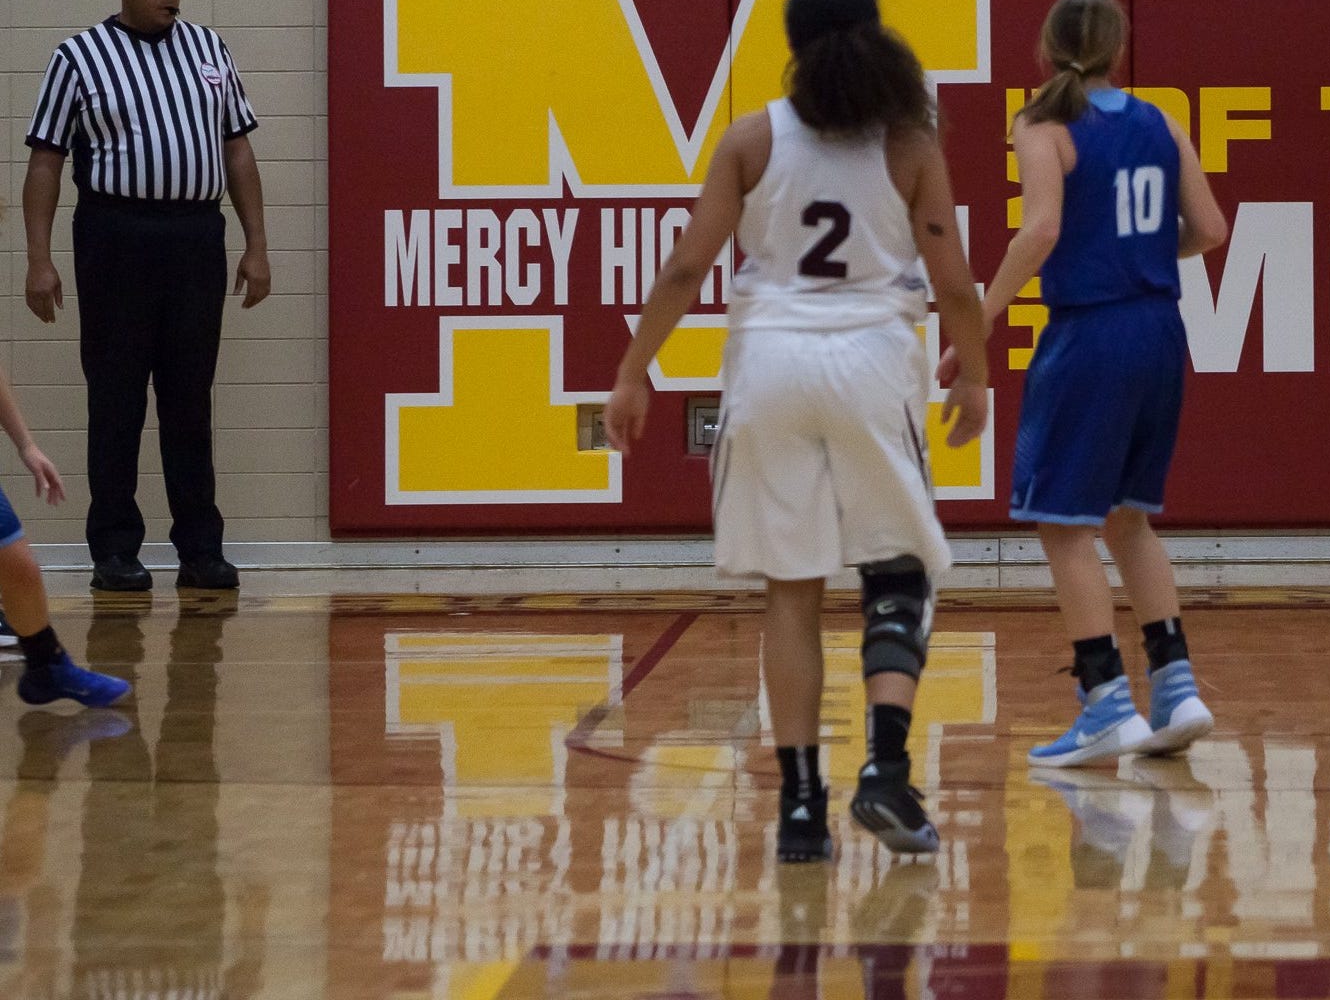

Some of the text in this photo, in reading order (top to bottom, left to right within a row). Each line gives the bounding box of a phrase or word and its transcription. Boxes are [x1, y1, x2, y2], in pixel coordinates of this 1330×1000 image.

[799, 201, 852, 277] 2
[1113, 166, 1165, 237] 10
[384, 208, 579, 306] MERCY
